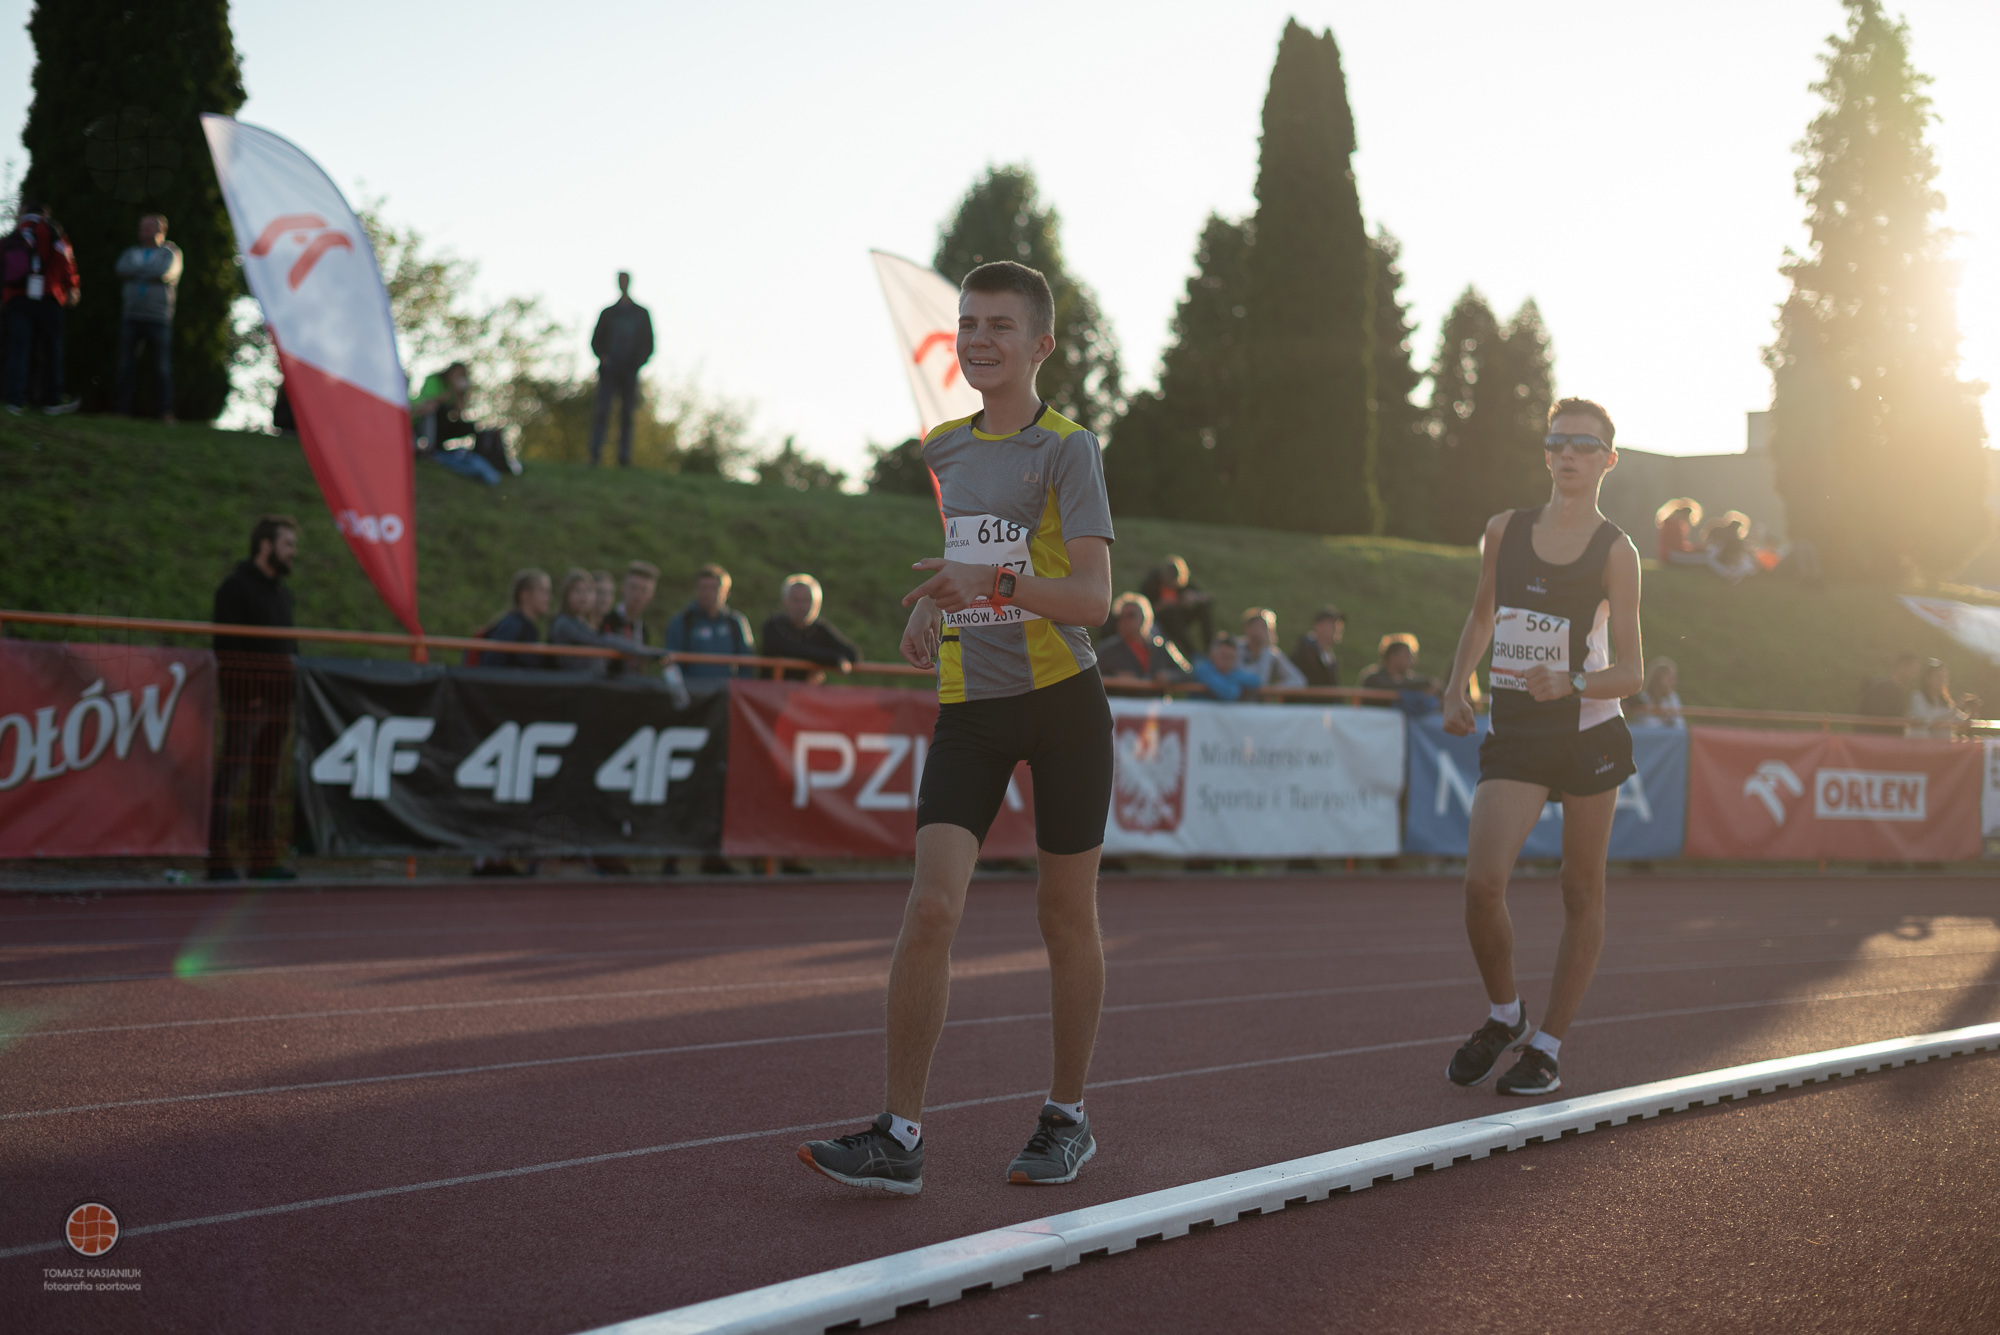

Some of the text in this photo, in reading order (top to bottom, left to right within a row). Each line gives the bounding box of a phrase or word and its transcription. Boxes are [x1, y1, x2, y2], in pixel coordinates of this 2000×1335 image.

[978, 519, 1020, 544] 618
[947, 608, 1022, 625] TARNÓW 2019
[1526, 613, 1565, 633] 567
[1494, 641, 1561, 661] GRUBECKI
[312, 716, 435, 798] 4F
[455, 721, 577, 802] 4F
[595, 726, 709, 804] 4F
[1822, 778, 1920, 812] ORLEN
